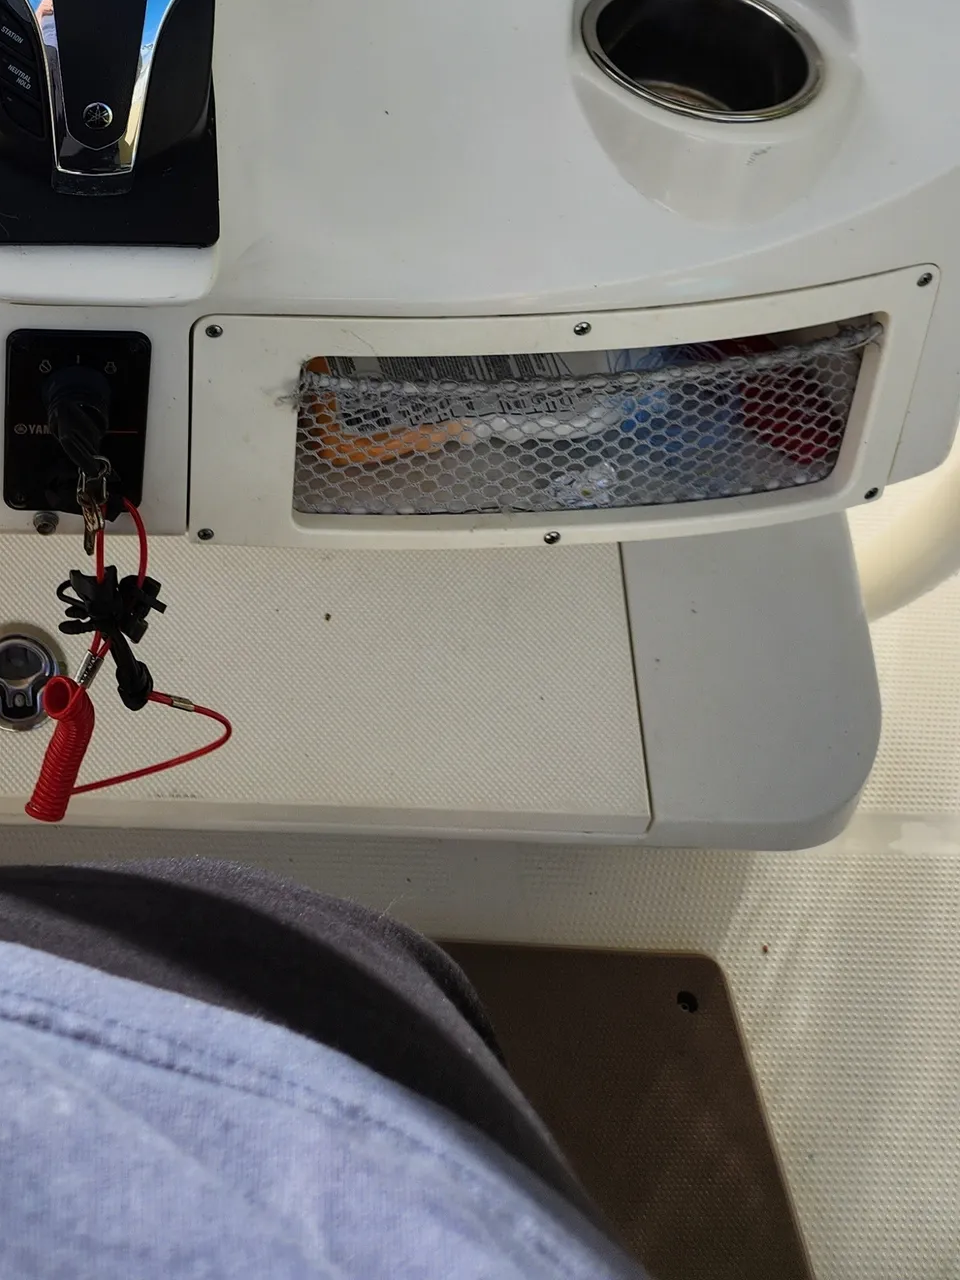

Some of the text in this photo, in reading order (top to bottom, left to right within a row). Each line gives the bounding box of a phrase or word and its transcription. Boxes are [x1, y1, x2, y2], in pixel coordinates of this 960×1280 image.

[0, 25, 24, 44] STATION
[7, 64, 32, 83] NEUTRAL
[15, 77, 32, 90] HOLD
